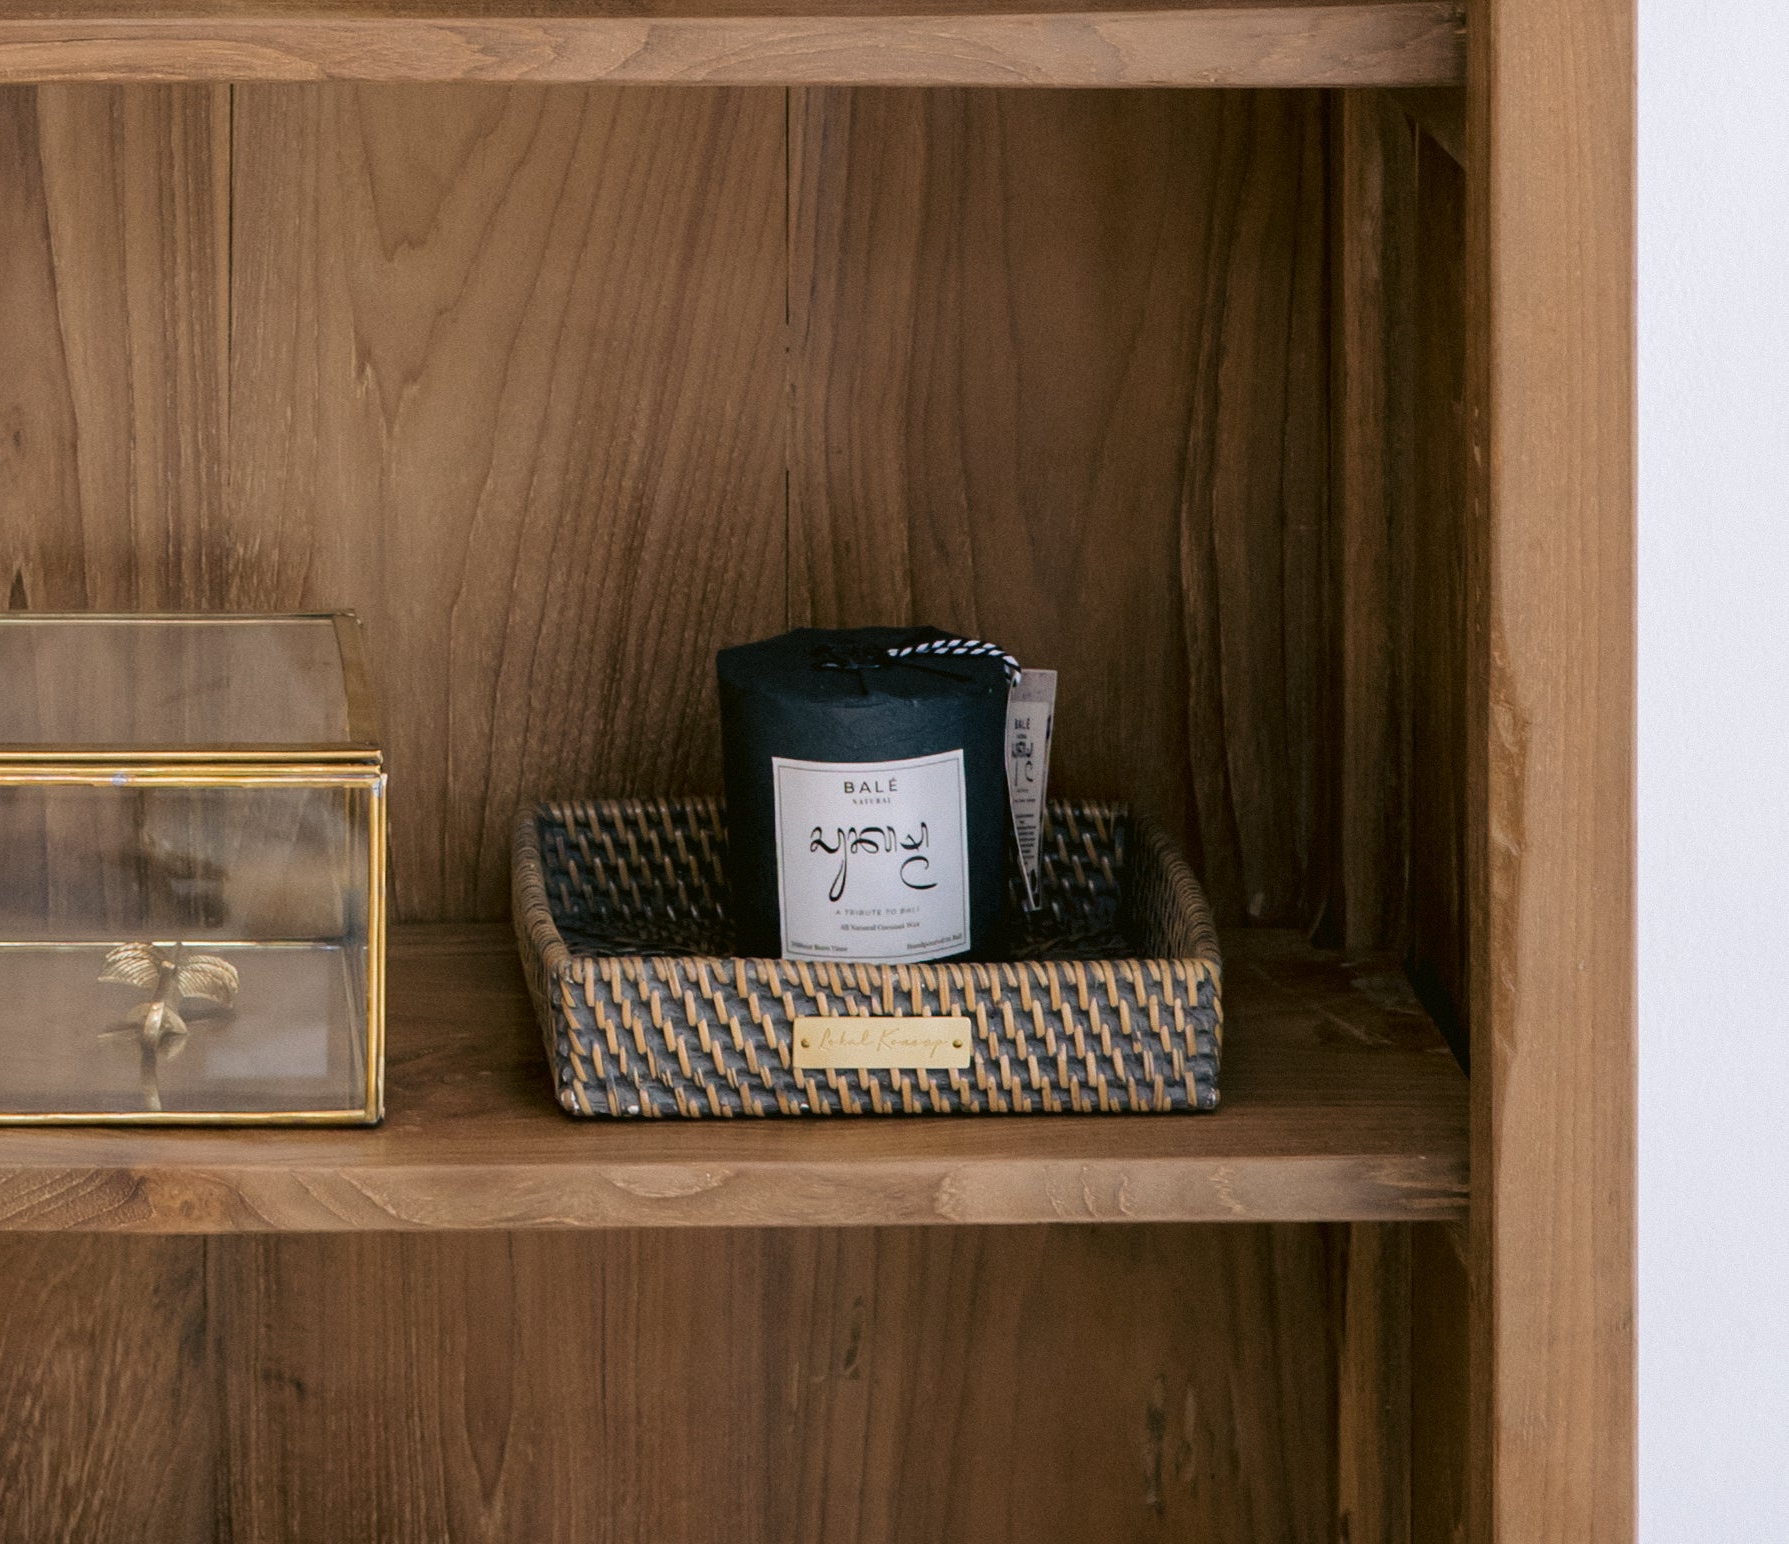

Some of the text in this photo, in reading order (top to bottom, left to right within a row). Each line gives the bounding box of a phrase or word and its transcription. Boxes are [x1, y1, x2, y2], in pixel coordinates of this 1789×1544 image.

[843, 777, 898, 794] BALÉ
[852, 797, 892, 805] NATURAL
[845, 908, 882, 916] TRIBUTE
[817, 1027, 873, 1051] Lokal
